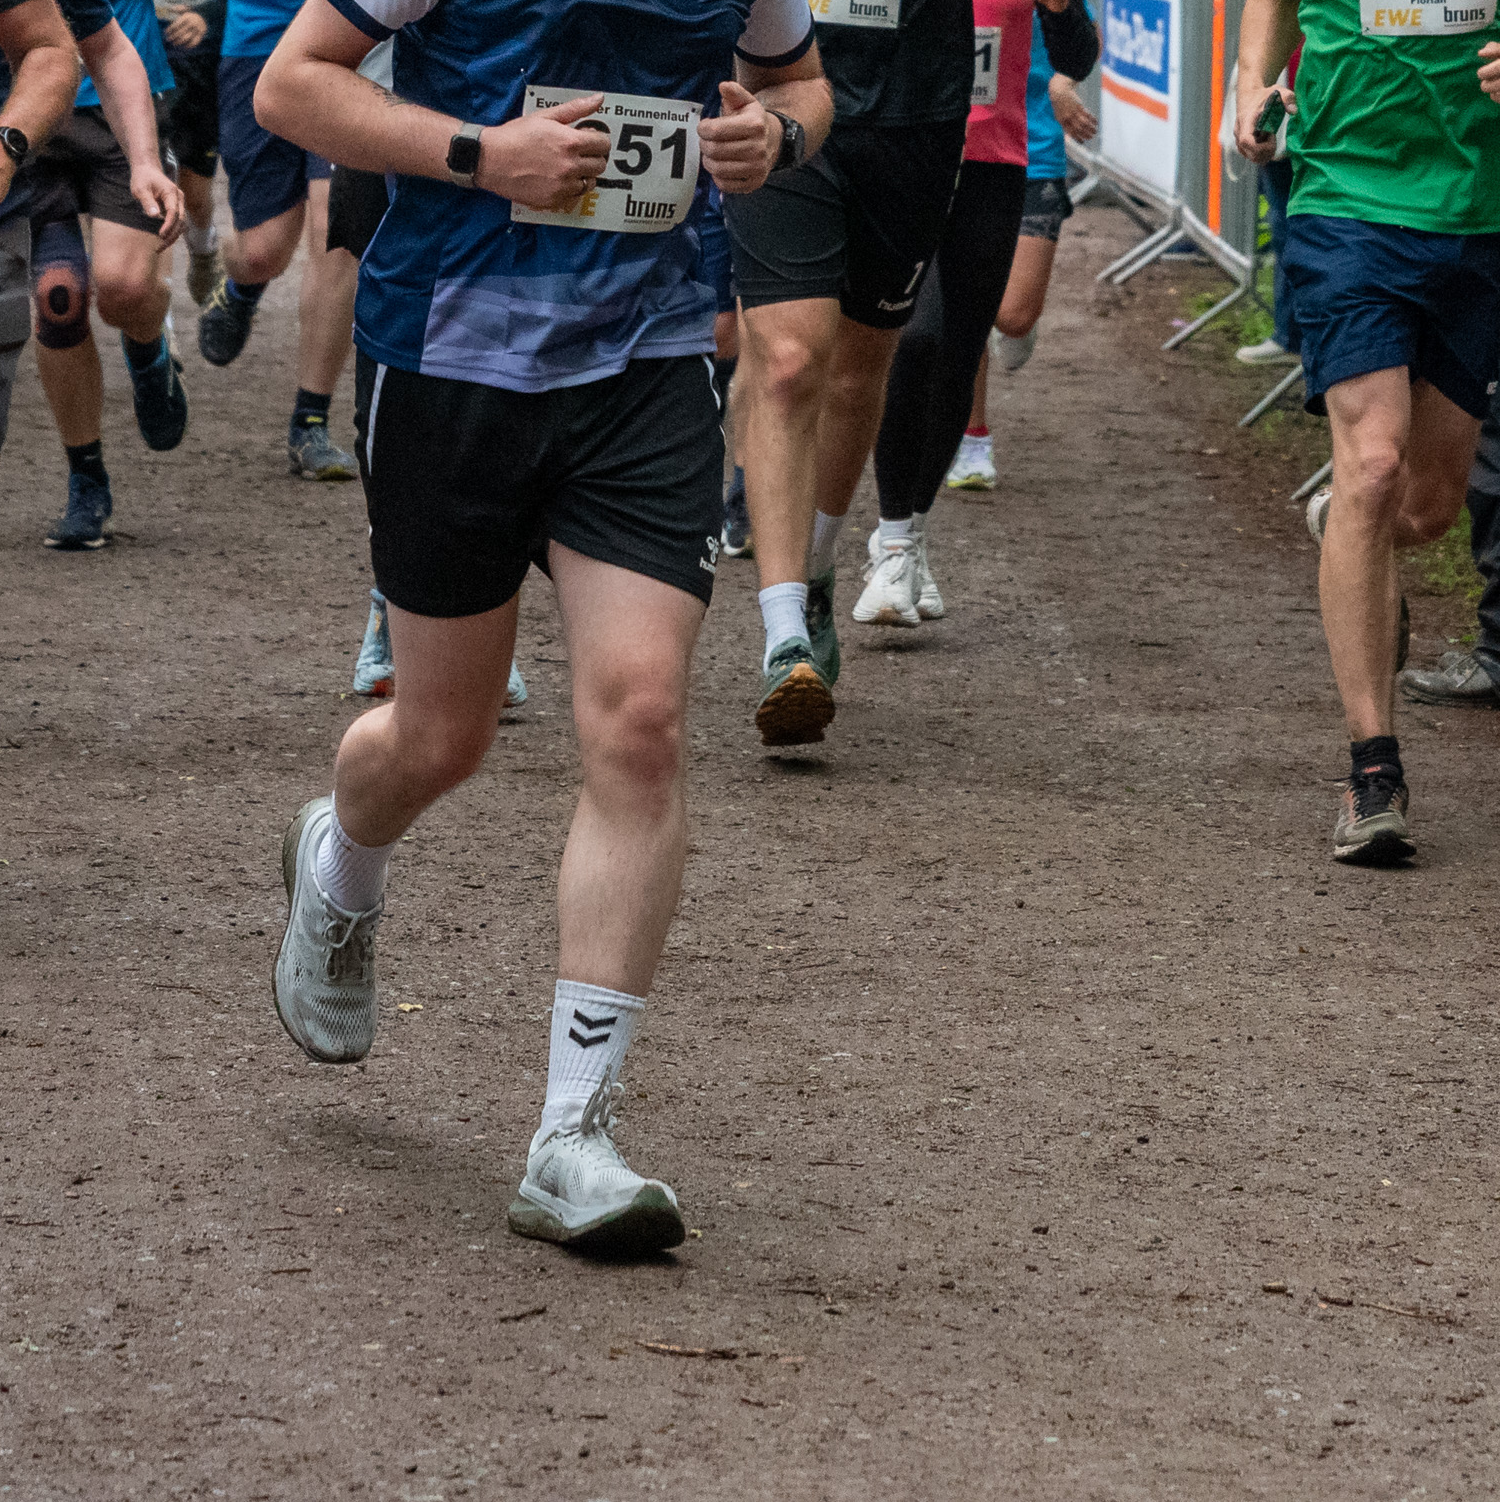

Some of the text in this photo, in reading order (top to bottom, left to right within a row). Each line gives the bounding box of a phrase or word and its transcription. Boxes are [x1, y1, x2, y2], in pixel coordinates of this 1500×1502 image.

[849, 0, 888, 17] bruns
[1374, 8, 1423, 27] EWE
[1444, 6, 1486, 23] bruns
[614, 105, 690, 122] Brunnenlauf
[625, 194, 677, 219] bruns
